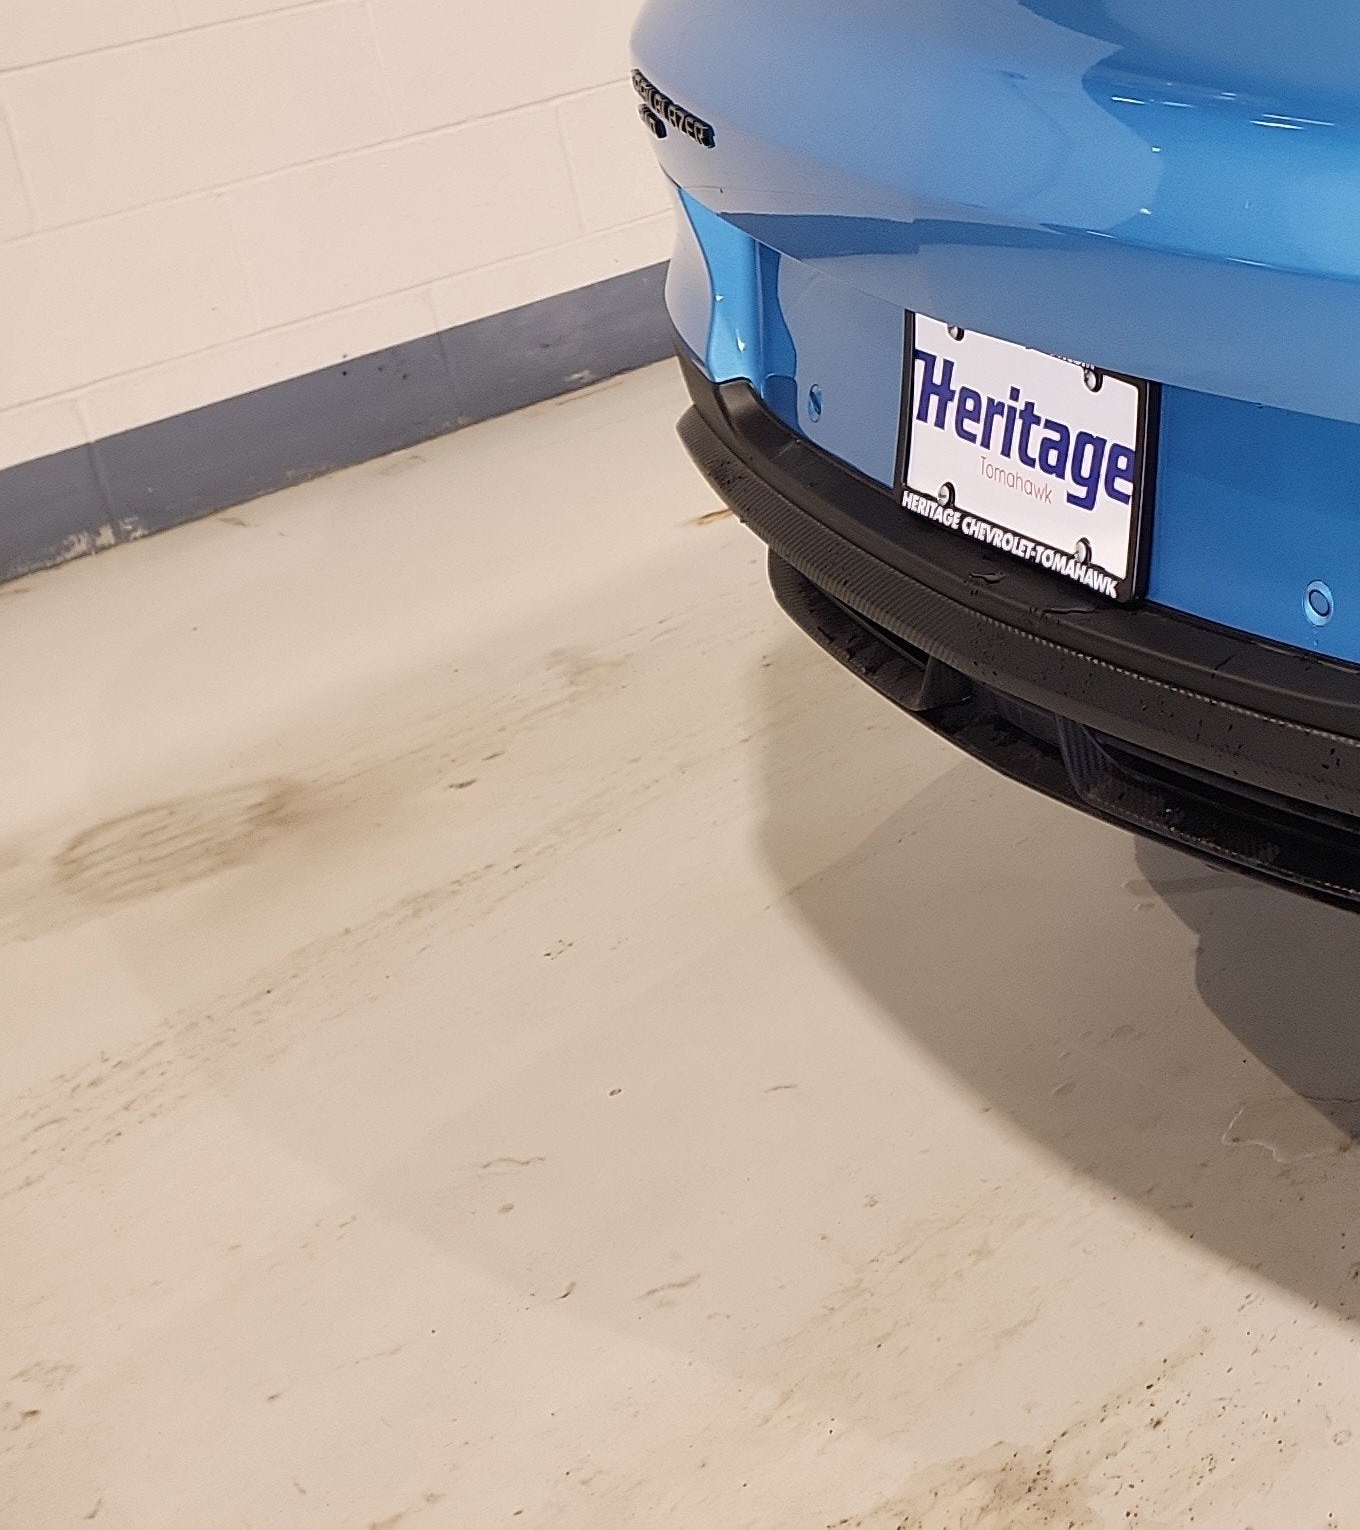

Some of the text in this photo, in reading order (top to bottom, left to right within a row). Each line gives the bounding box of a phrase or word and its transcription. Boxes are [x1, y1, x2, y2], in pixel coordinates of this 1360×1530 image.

[914, 348, 1136, 511] Heritage
[979, 455, 1053, 505] Tomahawk
[901, 490, 1118, 599] HERITAGE CHEVROLET-TOMAHAWK
